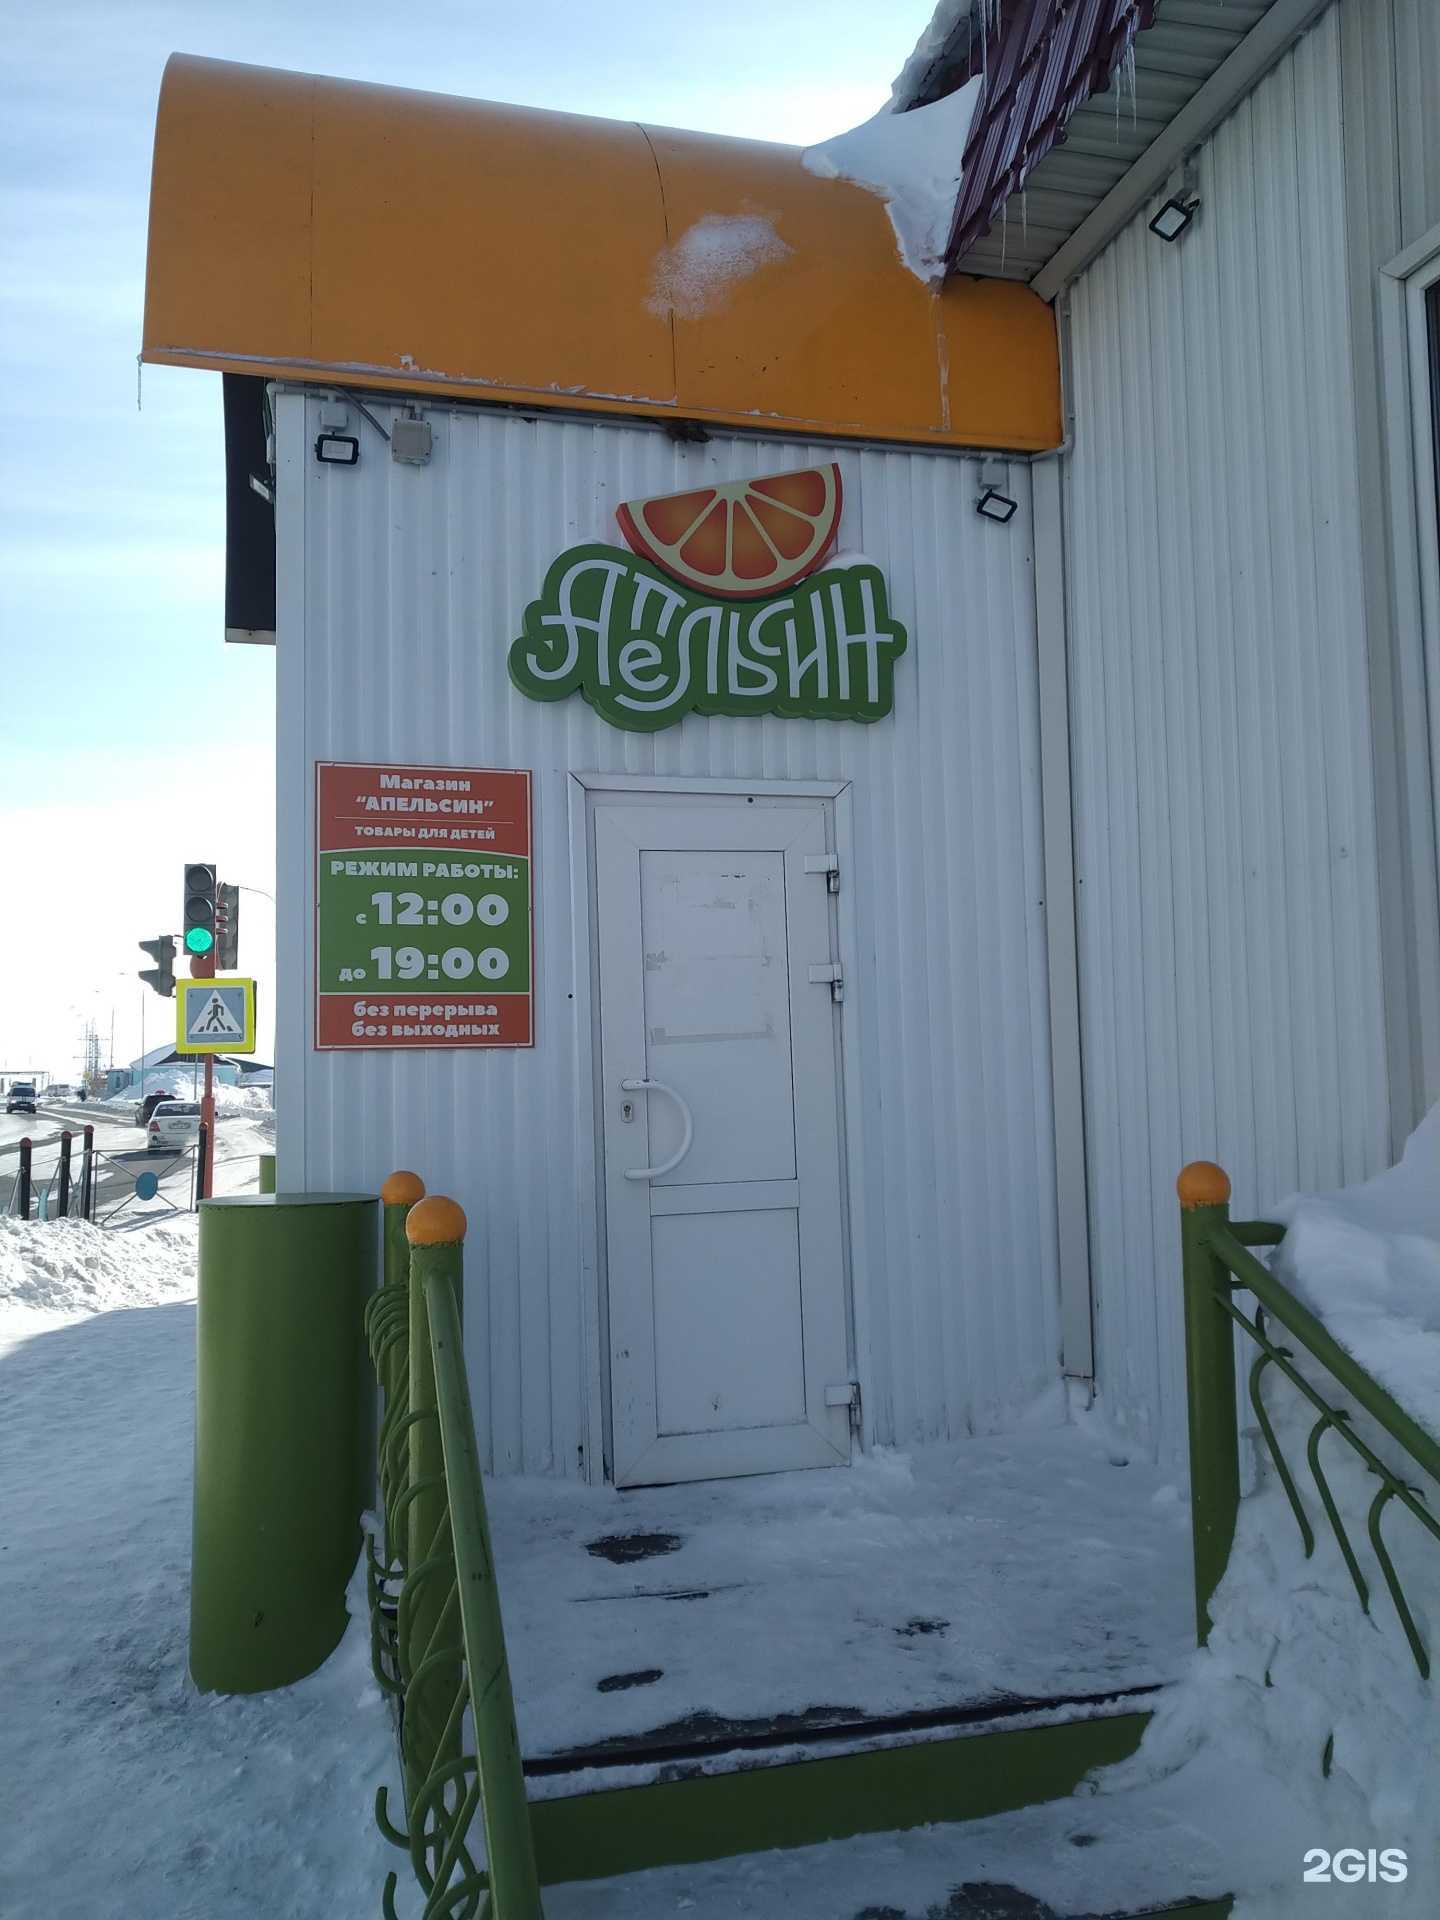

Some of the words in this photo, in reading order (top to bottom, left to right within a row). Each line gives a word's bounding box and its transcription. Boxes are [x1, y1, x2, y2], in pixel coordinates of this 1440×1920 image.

[379, 774, 471, 791] Магазин
[354, 826, 415, 838] ТОВАРЫ
[417, 828, 448, 839] ДЛЯ
[449, 827, 496, 840] ДЕТЕЙ
[330, 860, 418, 878] РЕЖИМ
[422, 862, 519, 879] РАБОТЫ:
[355, 912, 367, 925] с
[371, 891, 510, 926] 12:00
[338, 967, 367, 982] до
[370, 946, 510, 980] 19:00
[353, 1001, 388, 1017] без
[393, 1003, 498, 1020] перерыва
[351, 1020, 388, 1037] без
[391, 1022, 500, 1037] выходных
